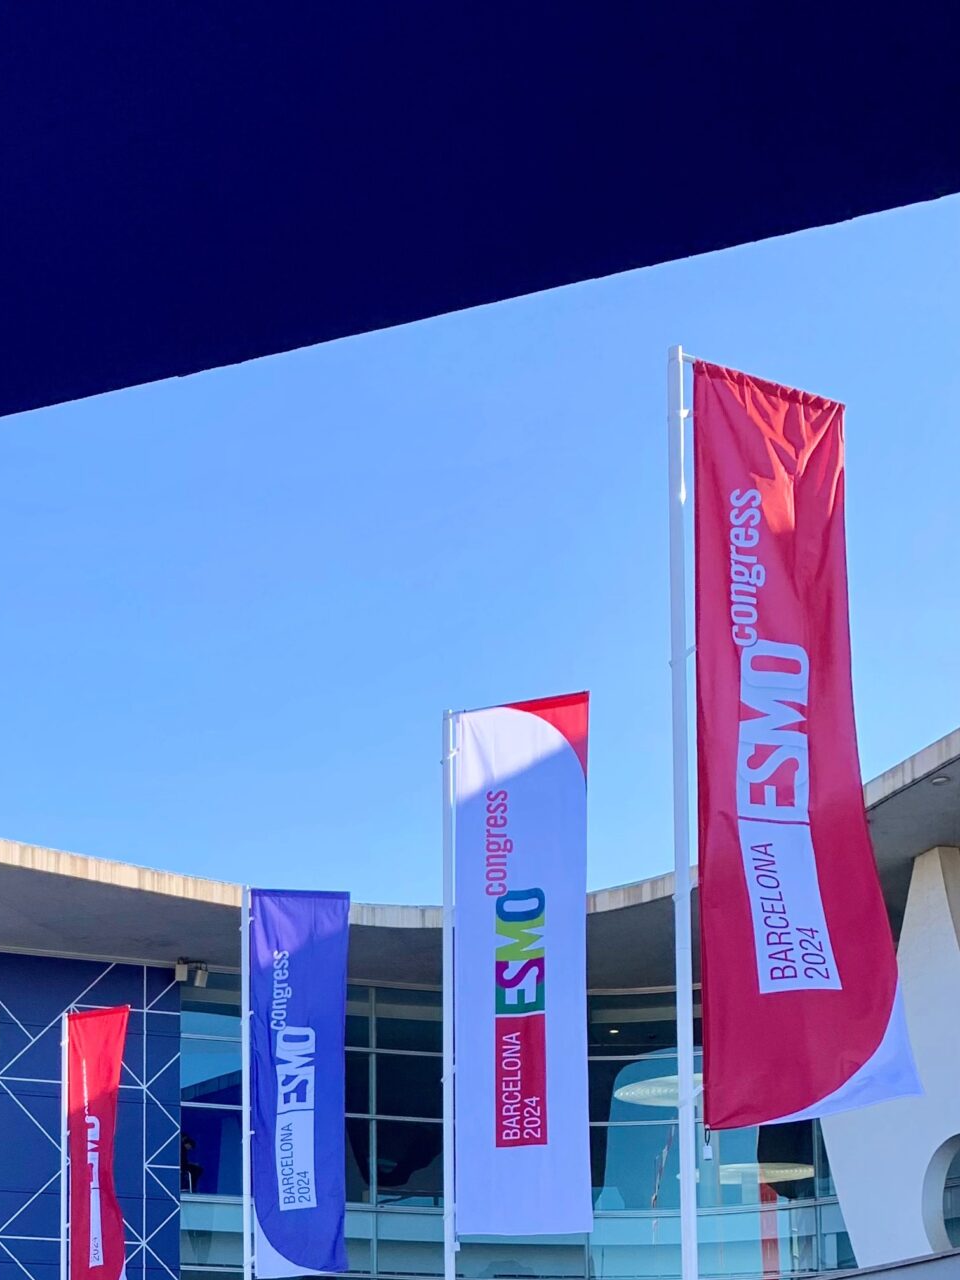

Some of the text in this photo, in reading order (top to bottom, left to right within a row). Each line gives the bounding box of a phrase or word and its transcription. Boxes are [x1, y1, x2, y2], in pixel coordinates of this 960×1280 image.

[730, 488, 810, 823] ESMO congress
[485, 790, 546, 1015] ESMO congress
[750, 842, 798, 981] BARCELONA
[795, 926, 830, 981] 2024
[271, 949, 316, 1112] ESMO congress
[502, 1031, 521, 1140] BARCELONA
[523, 1095, 541, 1139] 2024
[279, 1122, 296, 1204] BARCELONA
[297, 1170, 311, 1203] 2024
